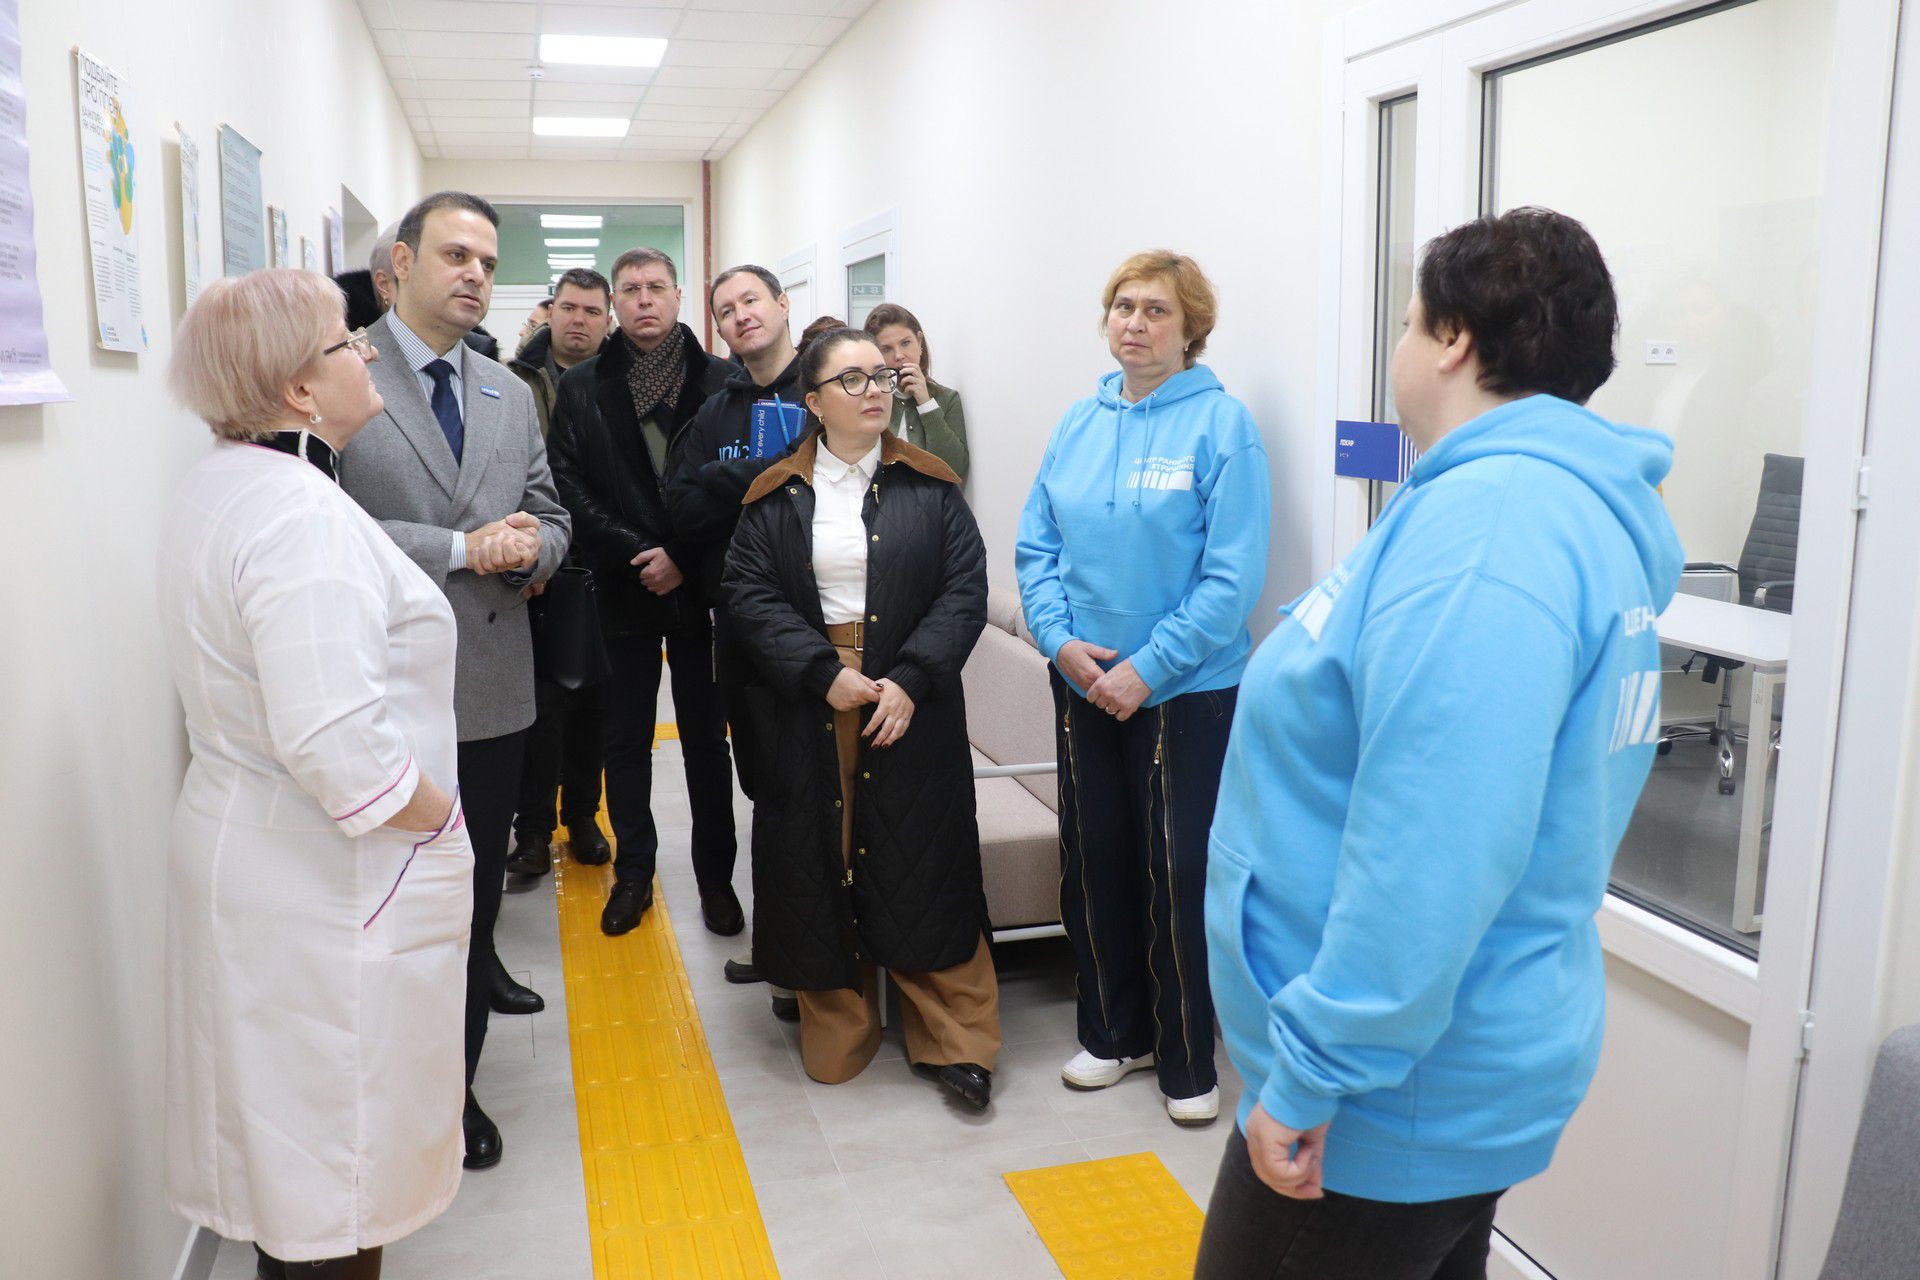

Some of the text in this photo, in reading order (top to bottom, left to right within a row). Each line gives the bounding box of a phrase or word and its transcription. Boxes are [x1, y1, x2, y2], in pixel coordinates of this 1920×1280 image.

[757, 409, 766, 427] child
[757, 427, 766, 447] every
[1622, 604, 1657, 639] ЦЕН
